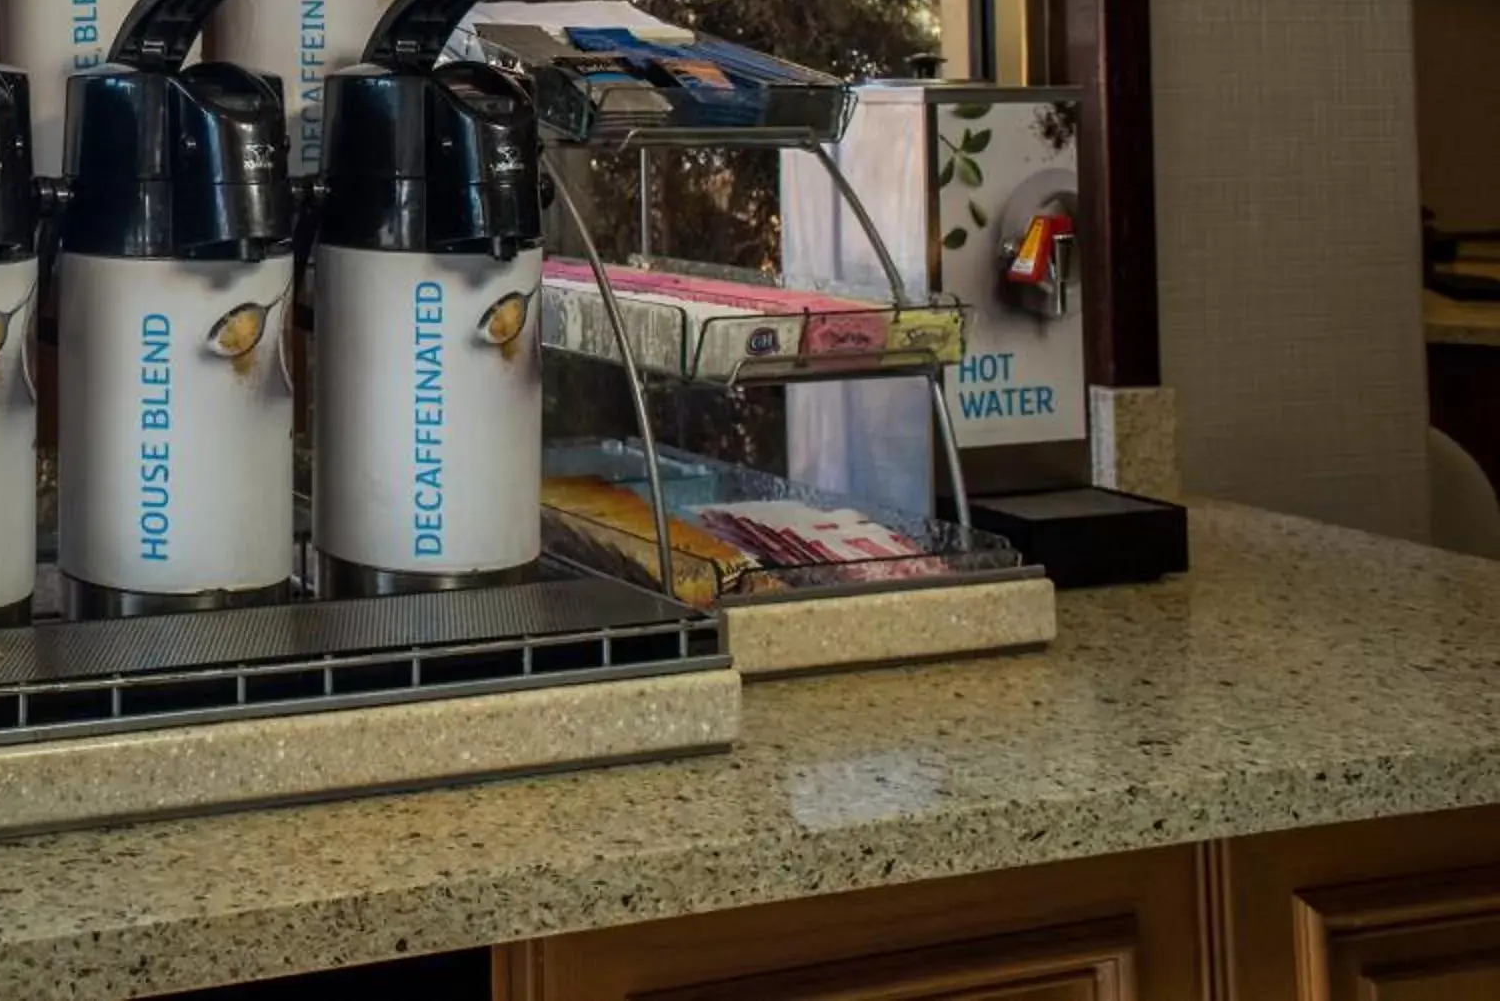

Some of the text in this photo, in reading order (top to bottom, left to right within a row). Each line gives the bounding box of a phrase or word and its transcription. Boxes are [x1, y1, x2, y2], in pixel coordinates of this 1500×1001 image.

[140, 312, 173, 563] HOUSE BLEND
[414, 281, 446, 559] DECAFFEINATED
[959, 353, 1014, 384] HOT
[959, 386, 1056, 418] WATER
